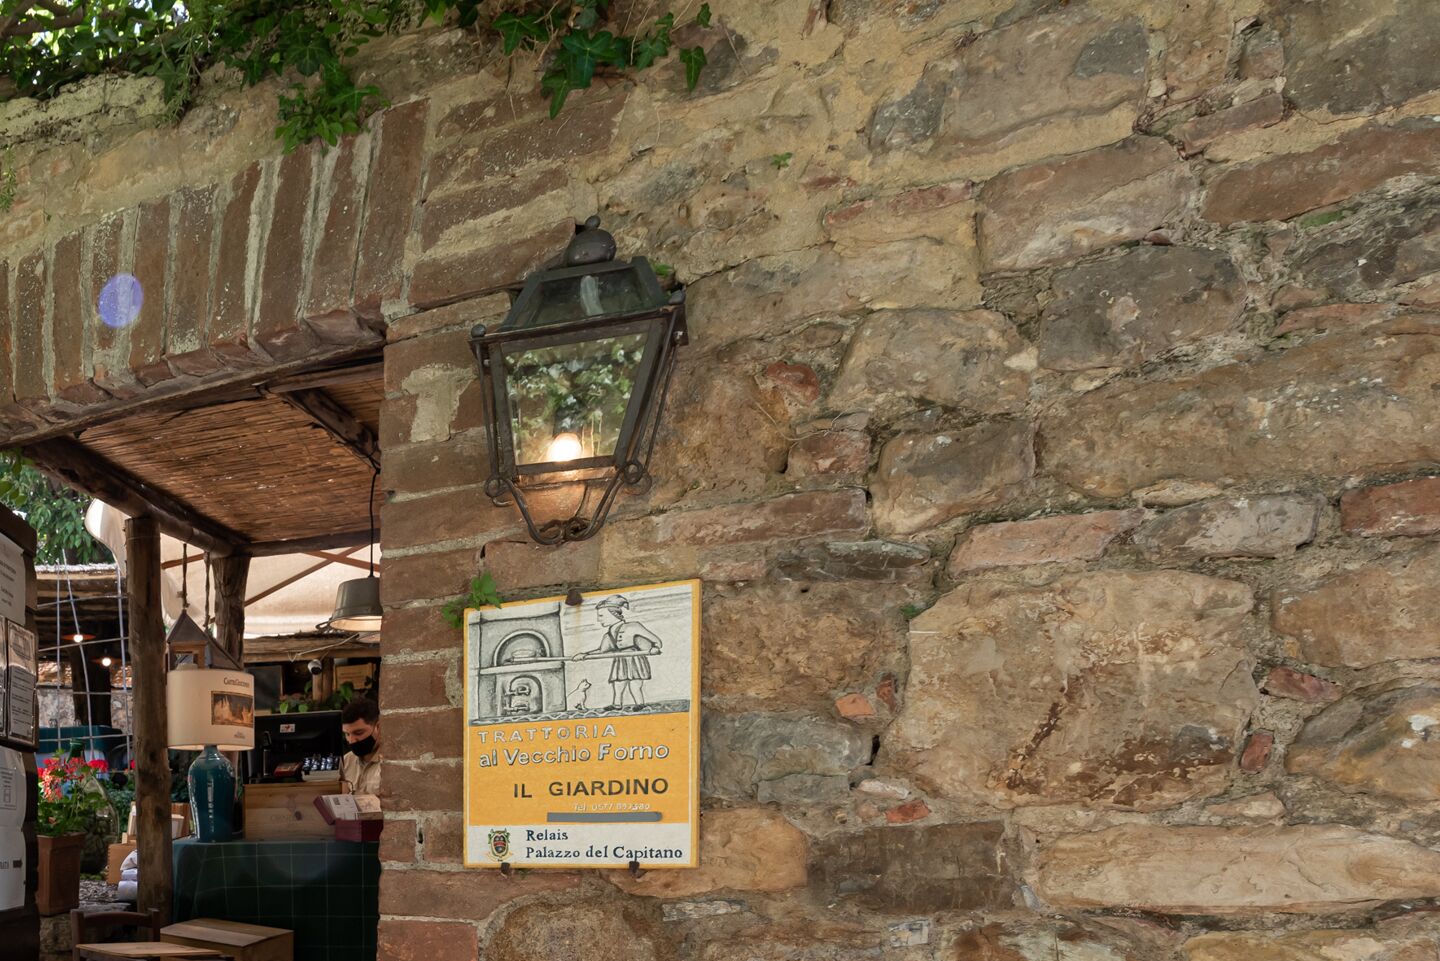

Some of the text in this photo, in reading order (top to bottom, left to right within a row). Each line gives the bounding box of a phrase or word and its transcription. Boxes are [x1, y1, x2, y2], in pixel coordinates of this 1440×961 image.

[477, 723, 617, 744] TRATTORIA
[479, 743, 670, 768] al Vecchio Forno
[513, 777, 669, 798] IL GIARDINO
[526, 829, 569, 842] Relais
[526, 845, 683, 861] Palazzo del Capitano
